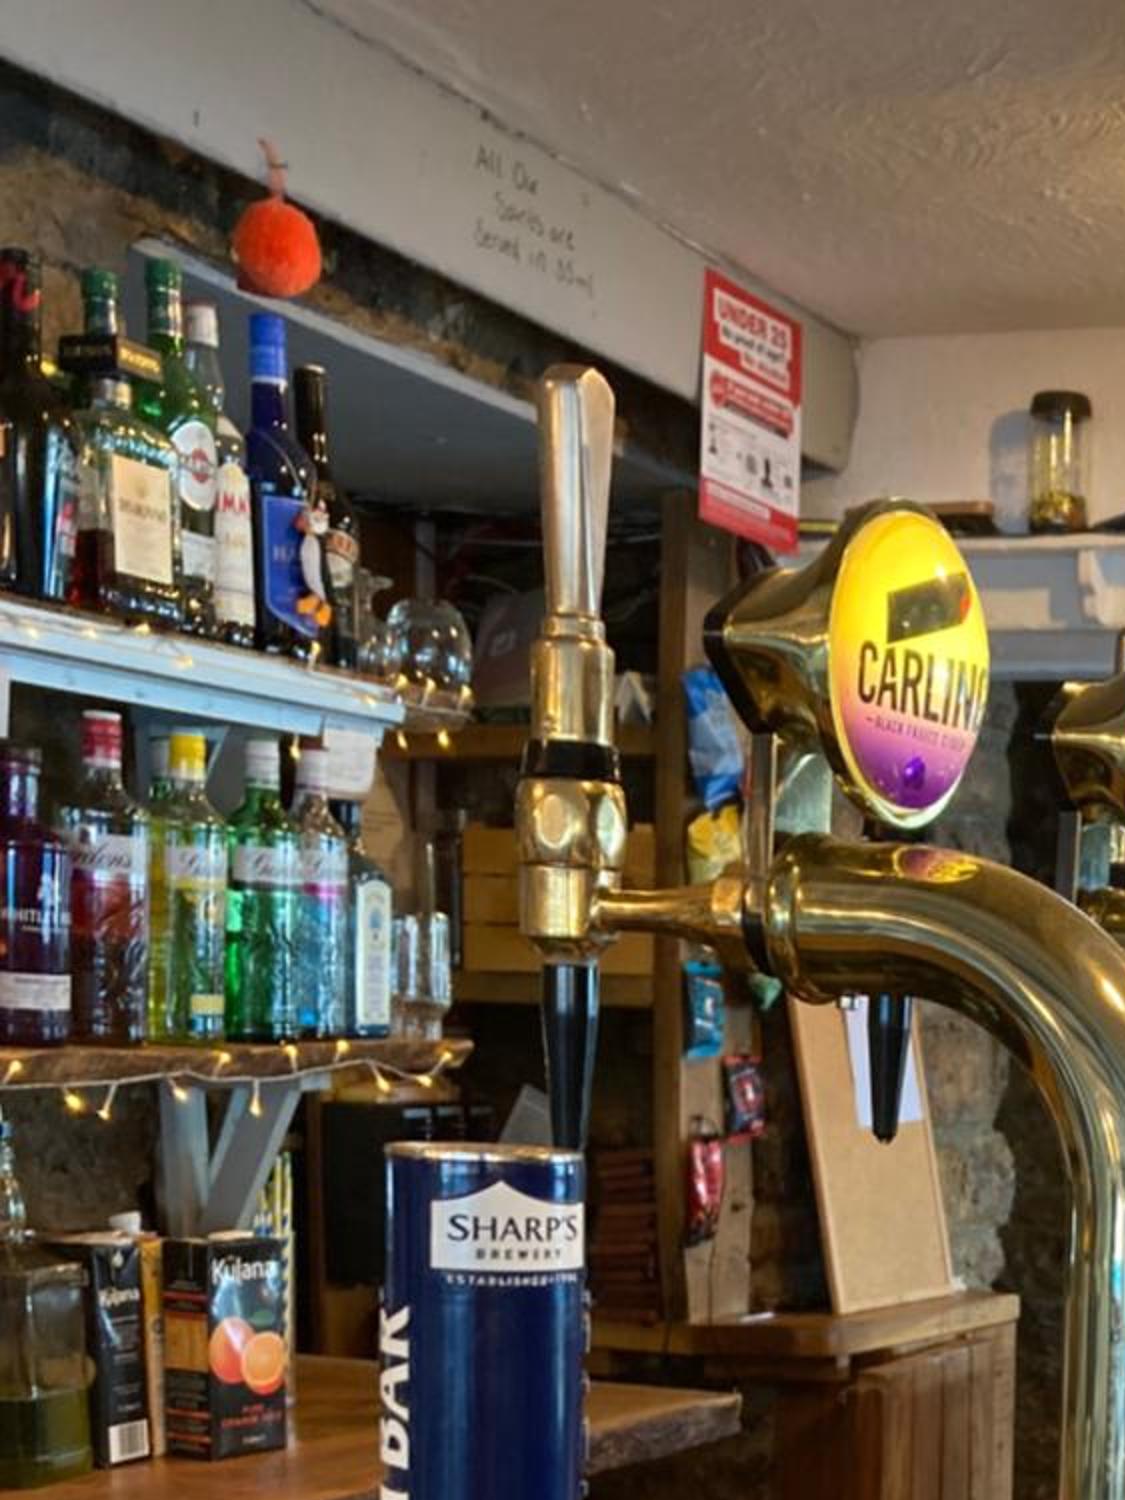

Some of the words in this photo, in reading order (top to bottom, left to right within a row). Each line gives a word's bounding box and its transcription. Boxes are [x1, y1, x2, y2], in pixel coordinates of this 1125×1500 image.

[475, 143, 502, 179] All
[718, 296, 768, 339] UNDER
[770, 322, 786, 350] 25
[447, 1213, 578, 1242] SHARP'S
[475, 1248, 562, 1261] BREWERY
[446, 1275, 548, 1287] ESTABLISHED
[379, 1305, 411, 1471] BAR
